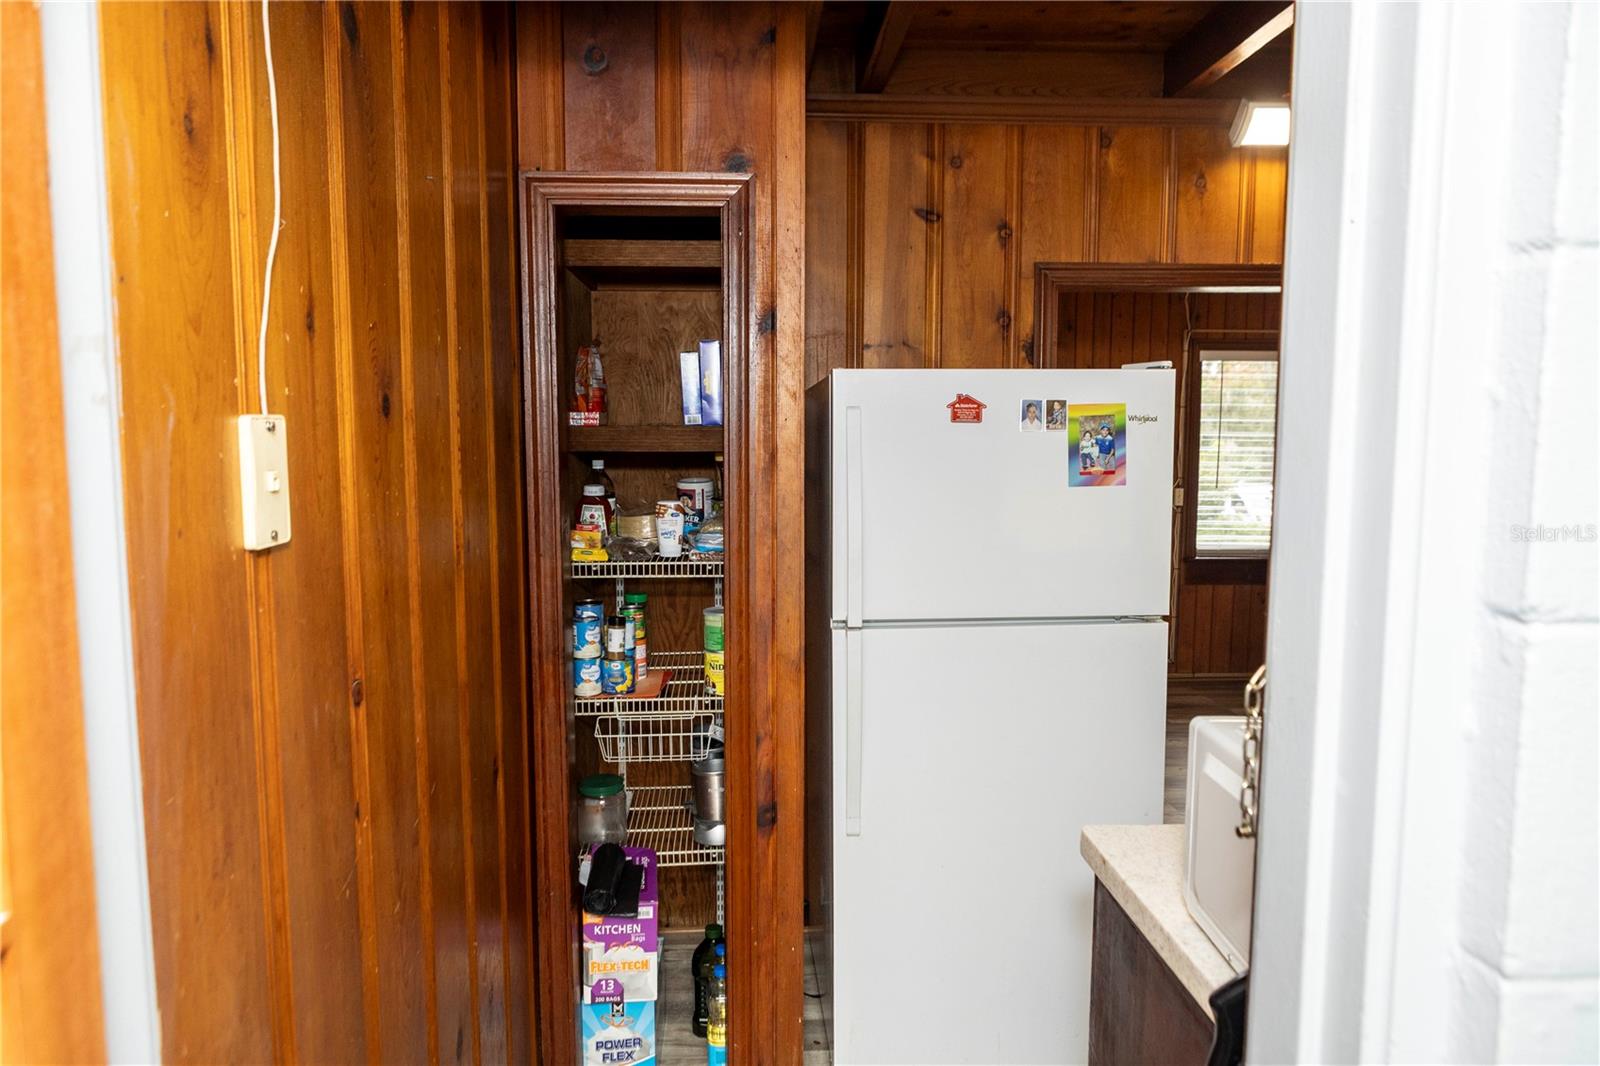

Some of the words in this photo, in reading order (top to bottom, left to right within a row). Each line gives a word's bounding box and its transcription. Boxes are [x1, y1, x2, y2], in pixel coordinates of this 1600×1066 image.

[1128, 414, 1158, 424] Whirlpool
[594, 923, 641, 935] KITCHEN
[600, 980, 614, 991] 13
[596, 1037, 643, 1051] POWER
[602, 1051, 634, 1062] FLEX
